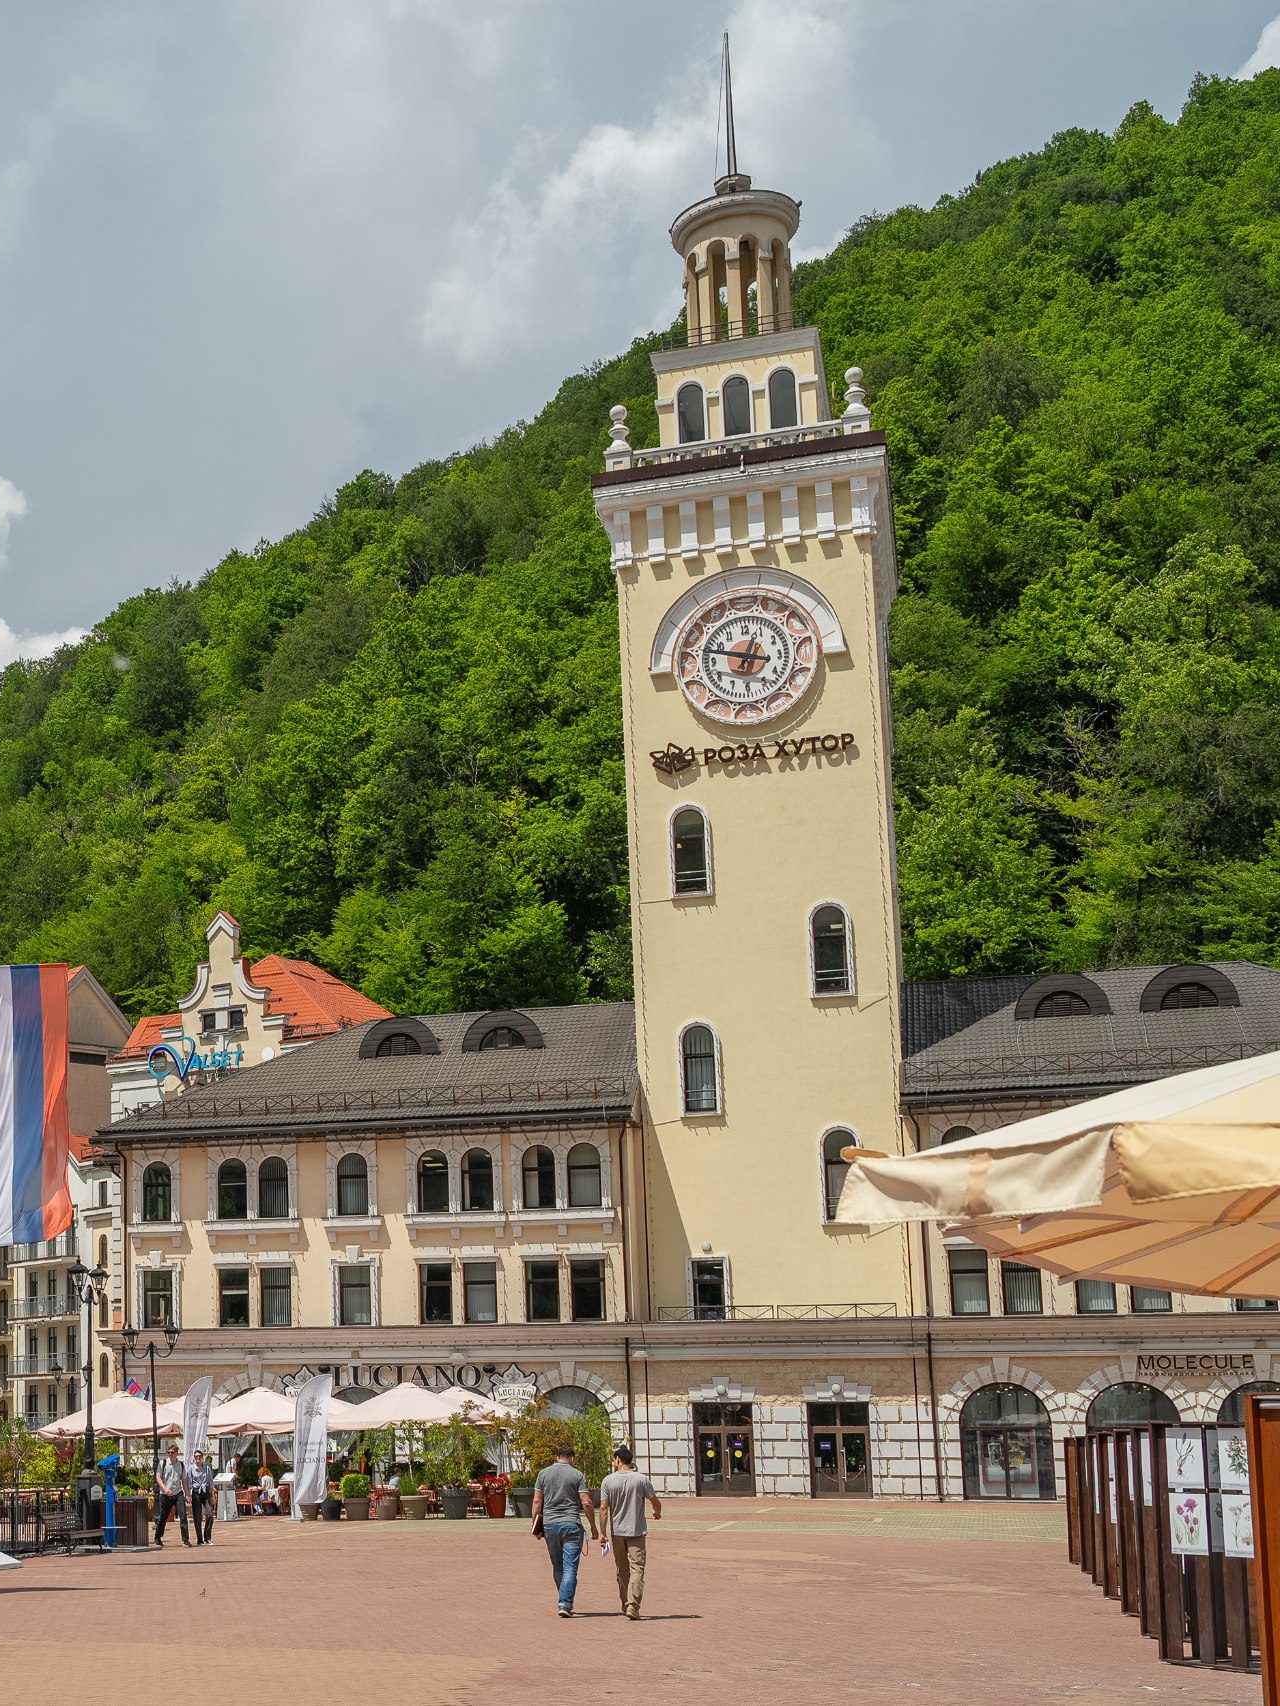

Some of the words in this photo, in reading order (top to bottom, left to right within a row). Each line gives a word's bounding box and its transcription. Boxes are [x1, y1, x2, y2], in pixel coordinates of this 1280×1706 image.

[740, 624, 750, 636] 12
[759, 627, 763, 637] 1
[726, 631, 733, 642] 11
[771, 635, 776, 646] 2
[777, 649, 782, 660] 3
[711, 657, 716, 667] 9
[772, 666, 779, 675] 4
[717, 671, 722, 682] 8
[761, 676, 767, 686] 5
[730, 680, 735, 690] 7
[745, 682, 751, 692] 6
[704, 743, 767, 765] РОЗА
[774, 733, 855, 758] ХУТОР
[1137, 1354, 1254, 1370] MOLECULE
[332, 1363, 483, 1388] LUCIANO
[497, 1387, 532, 1398] LUCIANO
[297, 1456, 325, 1464] LUCIANO
